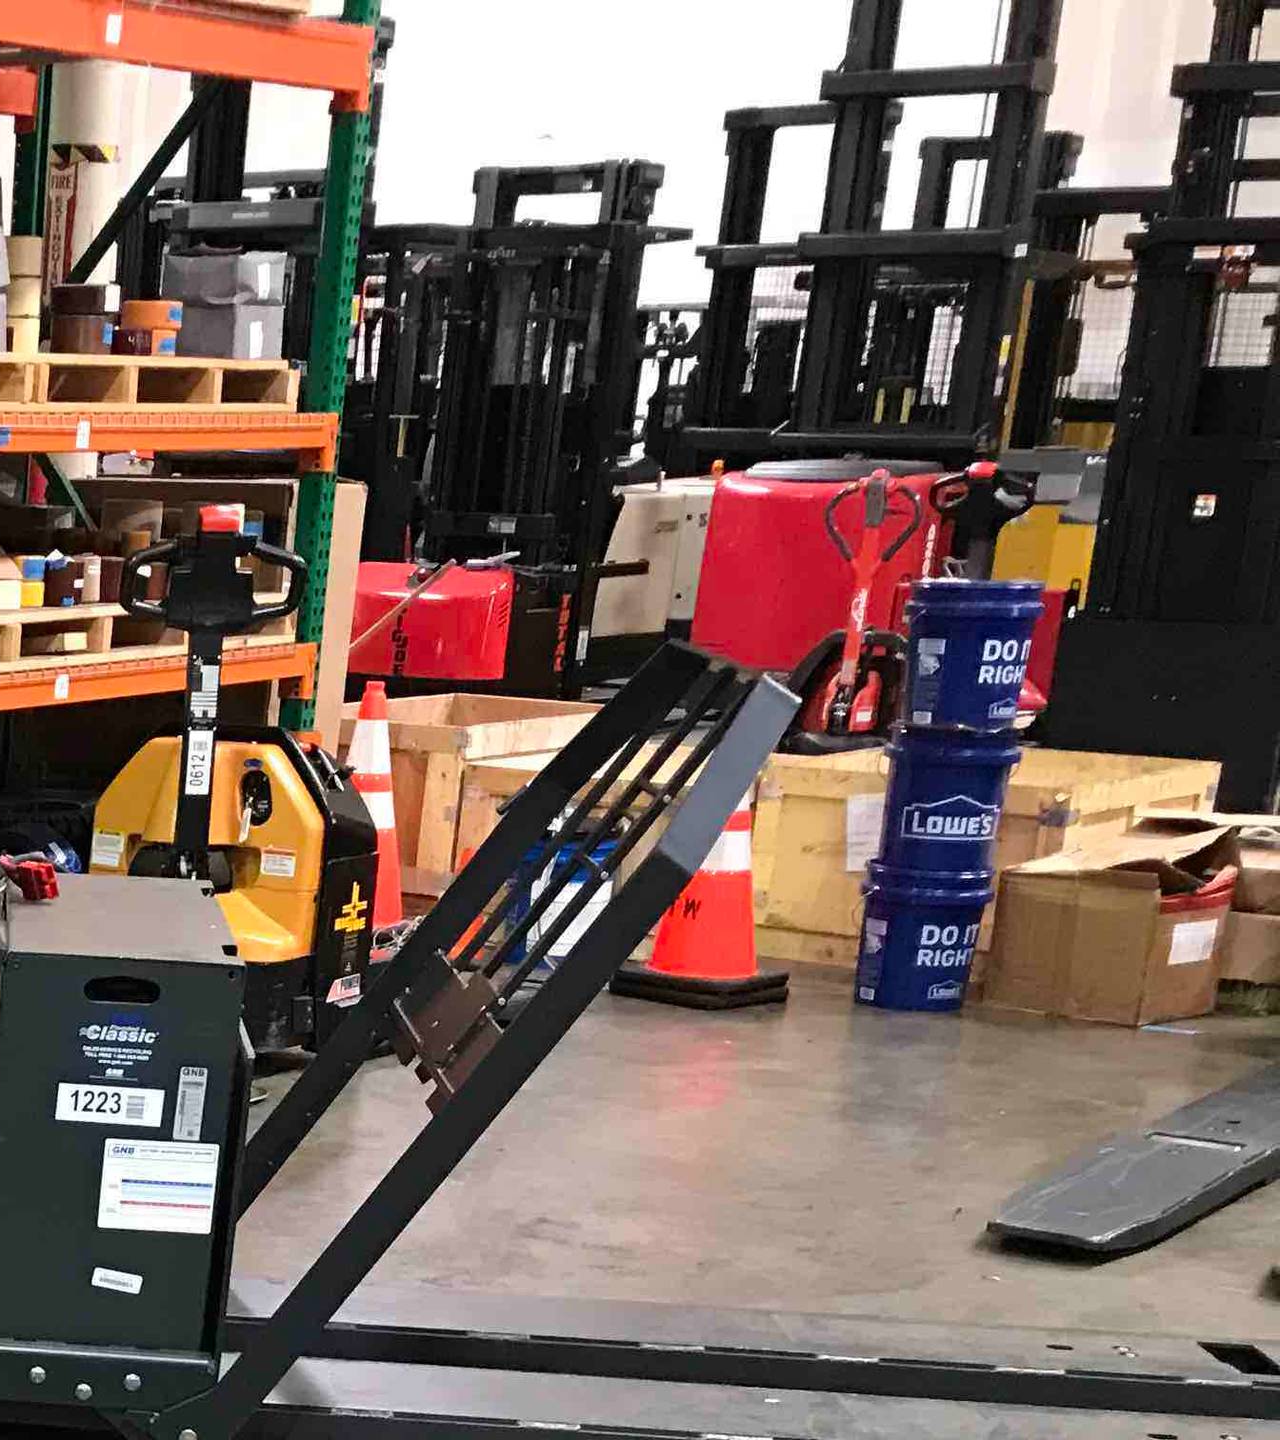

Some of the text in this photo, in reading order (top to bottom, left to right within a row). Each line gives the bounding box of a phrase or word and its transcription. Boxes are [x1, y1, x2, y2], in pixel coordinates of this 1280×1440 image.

[51, 174, 72, 190] FIRE
[982, 639, 1017, 662] DO
[977, 664, 1027, 685] RIGH
[189, 753, 206, 788] 0612
[912, 811, 993, 835] LOWE'S
[920, 924, 960, 946] DO
[916, 948, 974, 967] RIGHT
[81, 1023, 157, 1044] Classic
[182, 1067, 205, 1077] GNB
[70, 1089, 122, 1114] 1223
[112, 1146, 135, 1155] GNB
